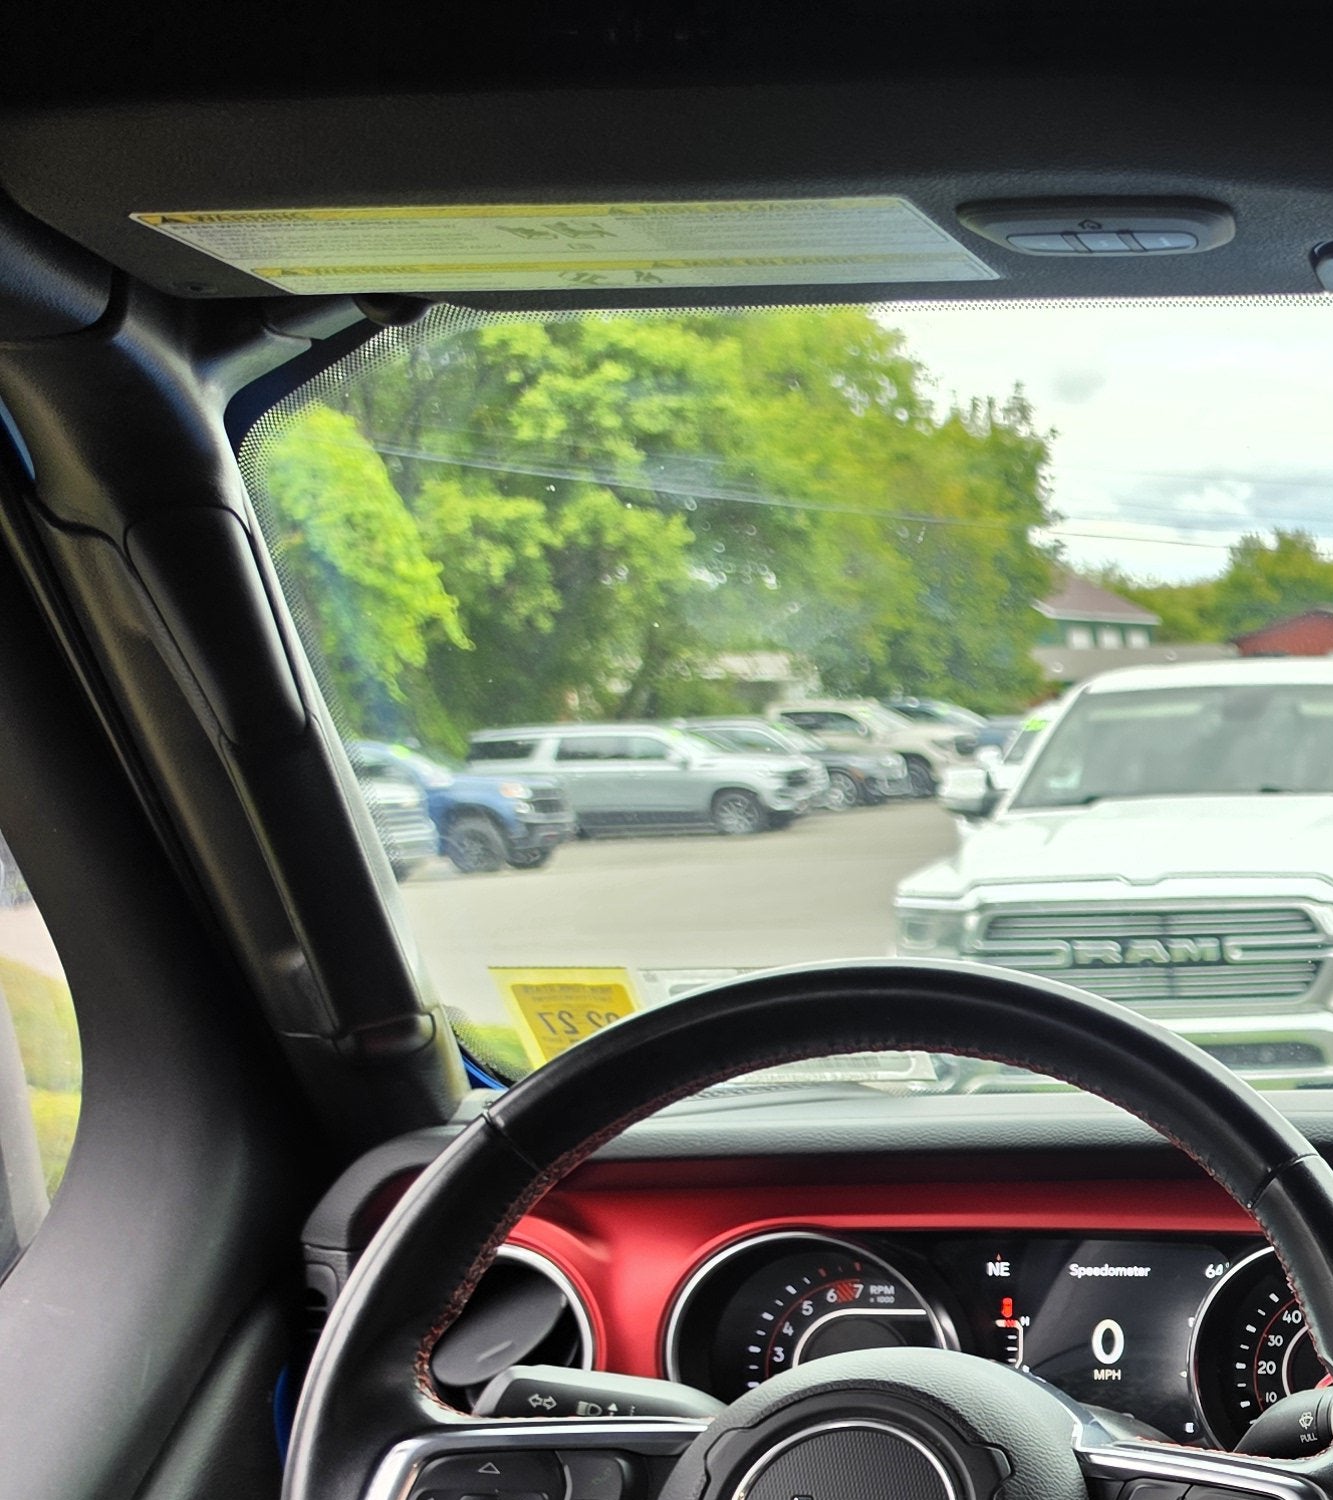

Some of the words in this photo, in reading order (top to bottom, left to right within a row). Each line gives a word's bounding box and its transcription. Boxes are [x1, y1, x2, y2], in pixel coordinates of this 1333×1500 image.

[1069, 936, 1223, 967] RAM
[987, 1262, 1010, 1277] NE
[1069, 1263, 1151, 1279] Speedometer
[826, 1288, 838, 1303] 6
[854, 1284, 864, 1299] 7
[869, 1285, 895, 1296] RPM
[801, 1301, 814, 1316] 5
[1282, 1310, 1302, 1324] 40
[782, 1322, 794, 1336] 4
[1091, 1318, 1125, 1365] 0
[1267, 1335, 1284, 1347] 30
[772, 1346, 785, 1363] 3
[1093, 1369, 1121, 1381] MPH
[1257, 1361, 1277, 1375] 20
[1265, 1391, 1278, 1403] 10
[1299, 1433, 1318, 1443] PULL
